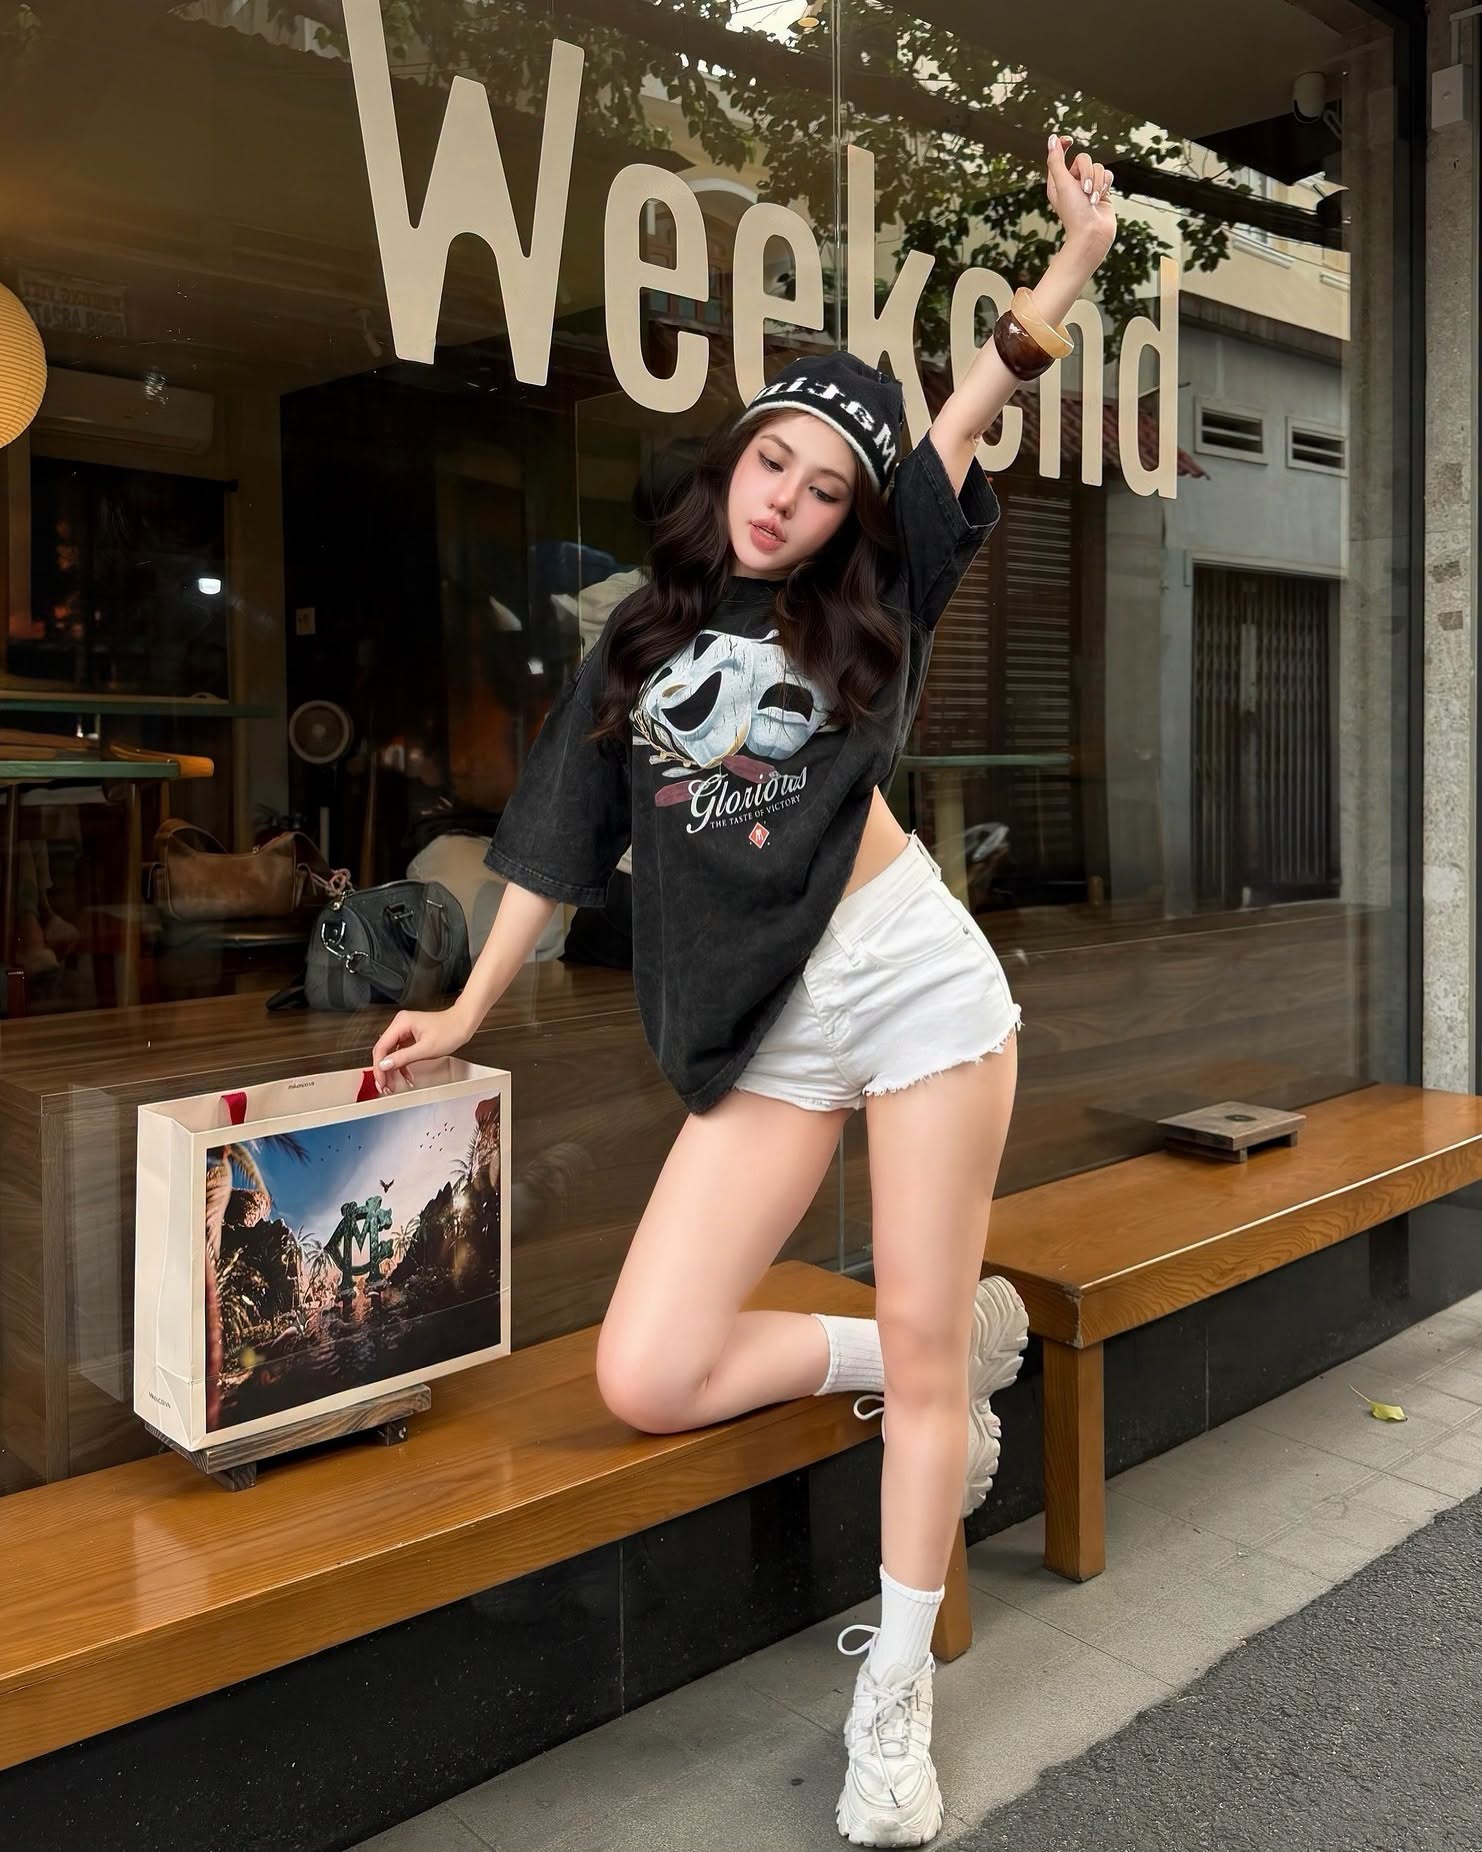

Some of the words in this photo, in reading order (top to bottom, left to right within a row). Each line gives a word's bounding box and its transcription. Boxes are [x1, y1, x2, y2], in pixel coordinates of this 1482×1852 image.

[343, 0, 1178, 499] Weekend
[686, 766, 807, 834] Glorious
[710, 819, 728, 829] THE
[729, 812, 753, 826] TASTE
[754, 808, 765, 818] OF
[766, 794, 801, 814] VICTORY
